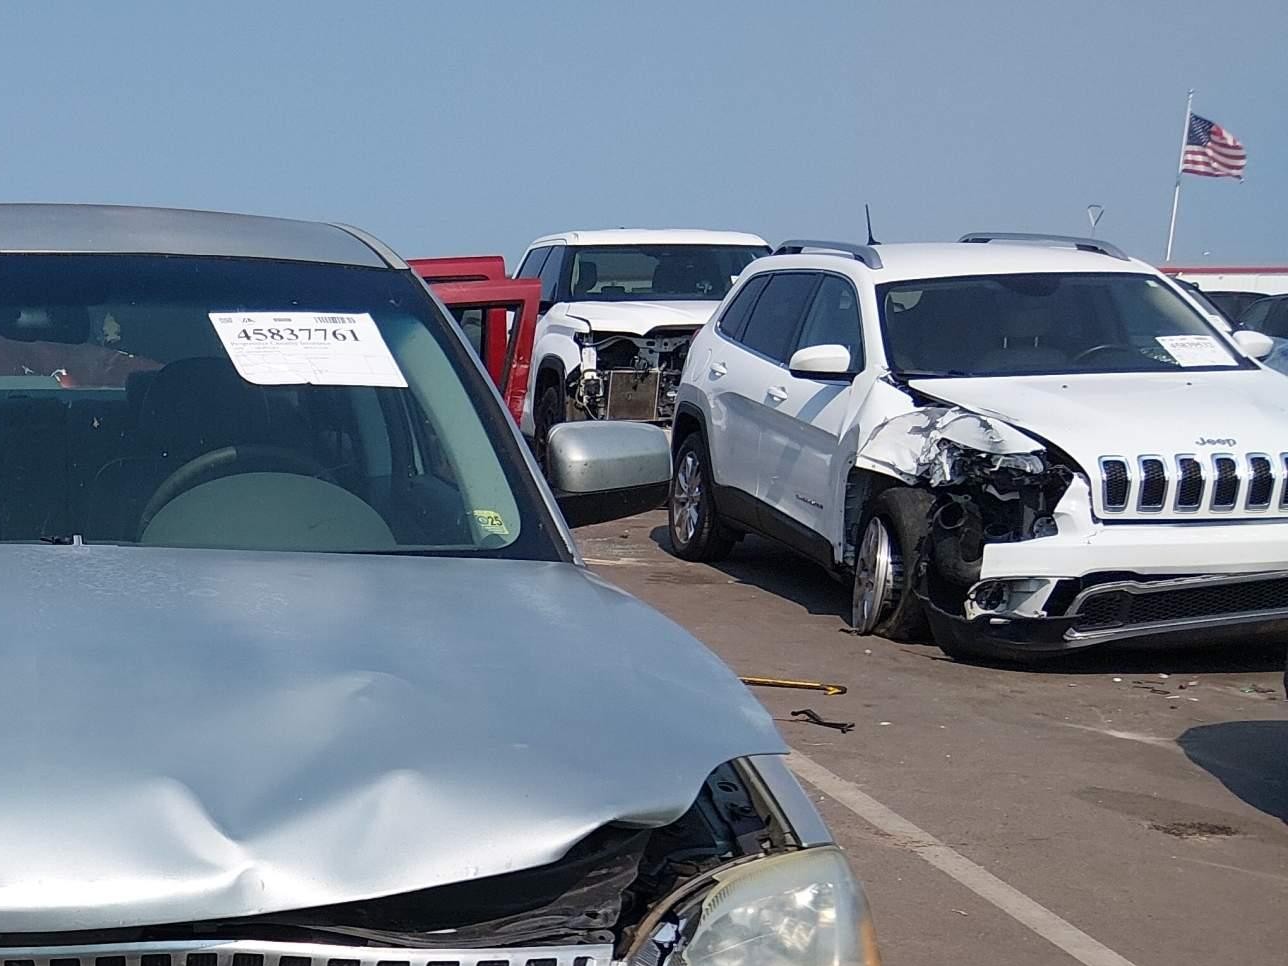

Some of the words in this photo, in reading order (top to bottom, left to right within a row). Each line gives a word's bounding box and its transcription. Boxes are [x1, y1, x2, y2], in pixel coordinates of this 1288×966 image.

[237, 327, 361, 342] 45837761
[1195, 436, 1237, 447] Jeep
[487, 515, 503, 526] 25
